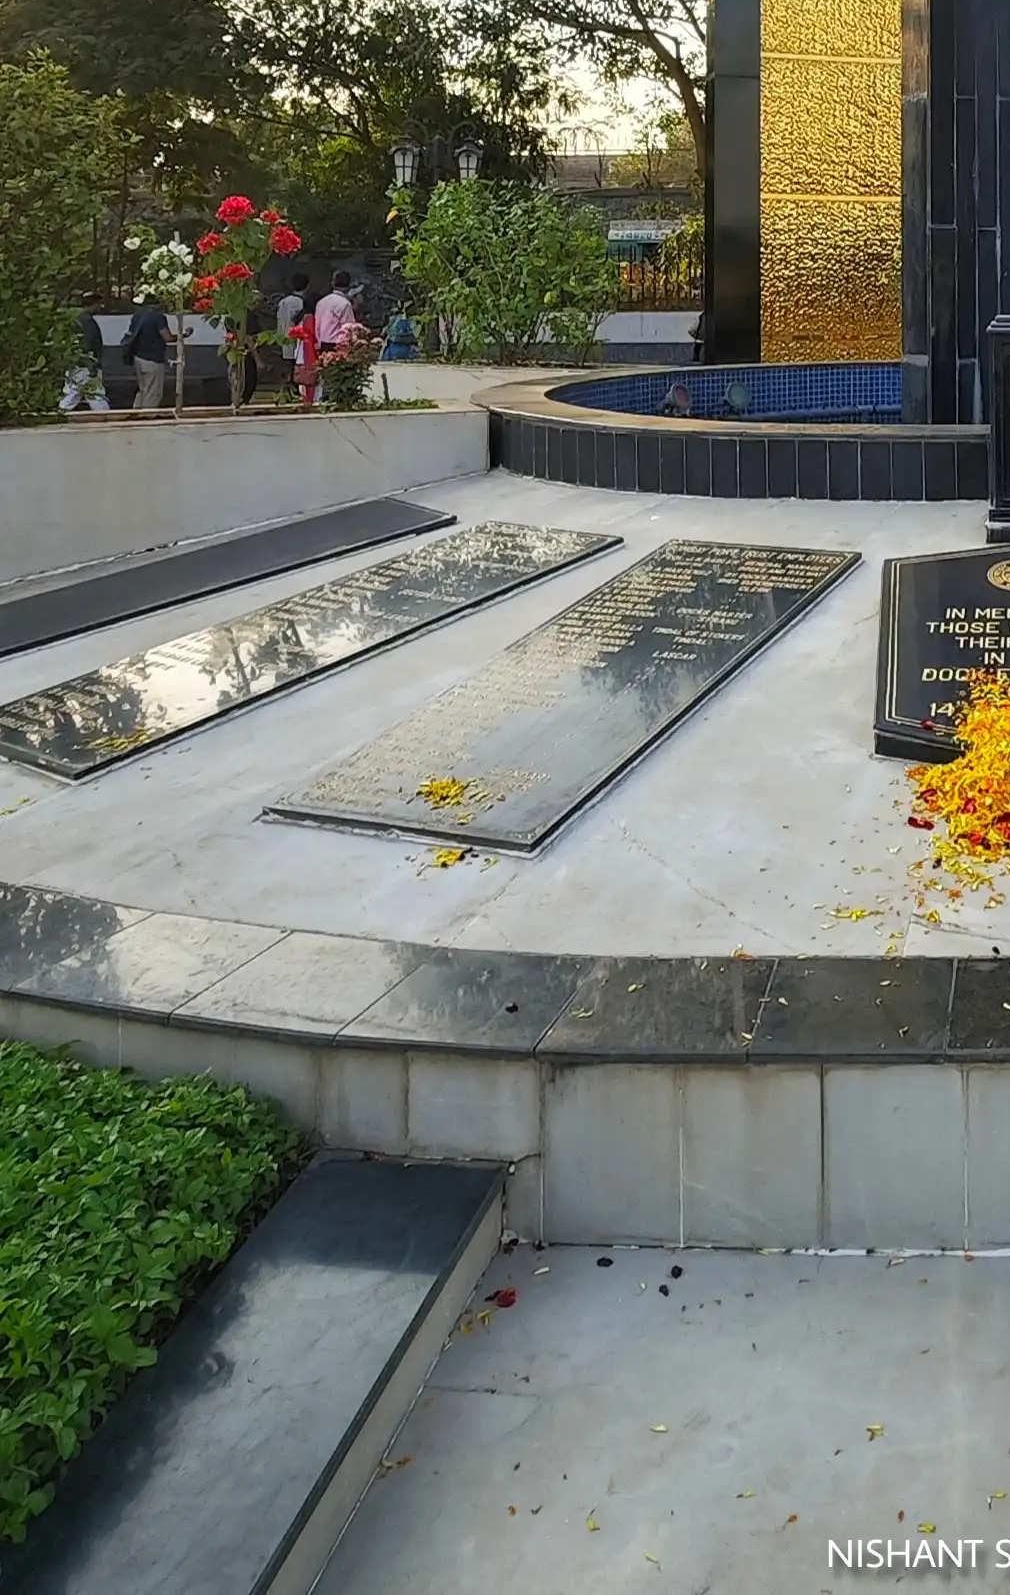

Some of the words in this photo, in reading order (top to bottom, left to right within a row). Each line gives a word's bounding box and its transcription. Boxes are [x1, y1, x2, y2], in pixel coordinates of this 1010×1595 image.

[776, 552, 844, 562] EMPLOYEES
[946, 608, 966, 619] IN
[926, 622, 1000, 634] THOSE
[650, 650, 699, 659] LASCAR
[984, 652, 1005, 664] IN
